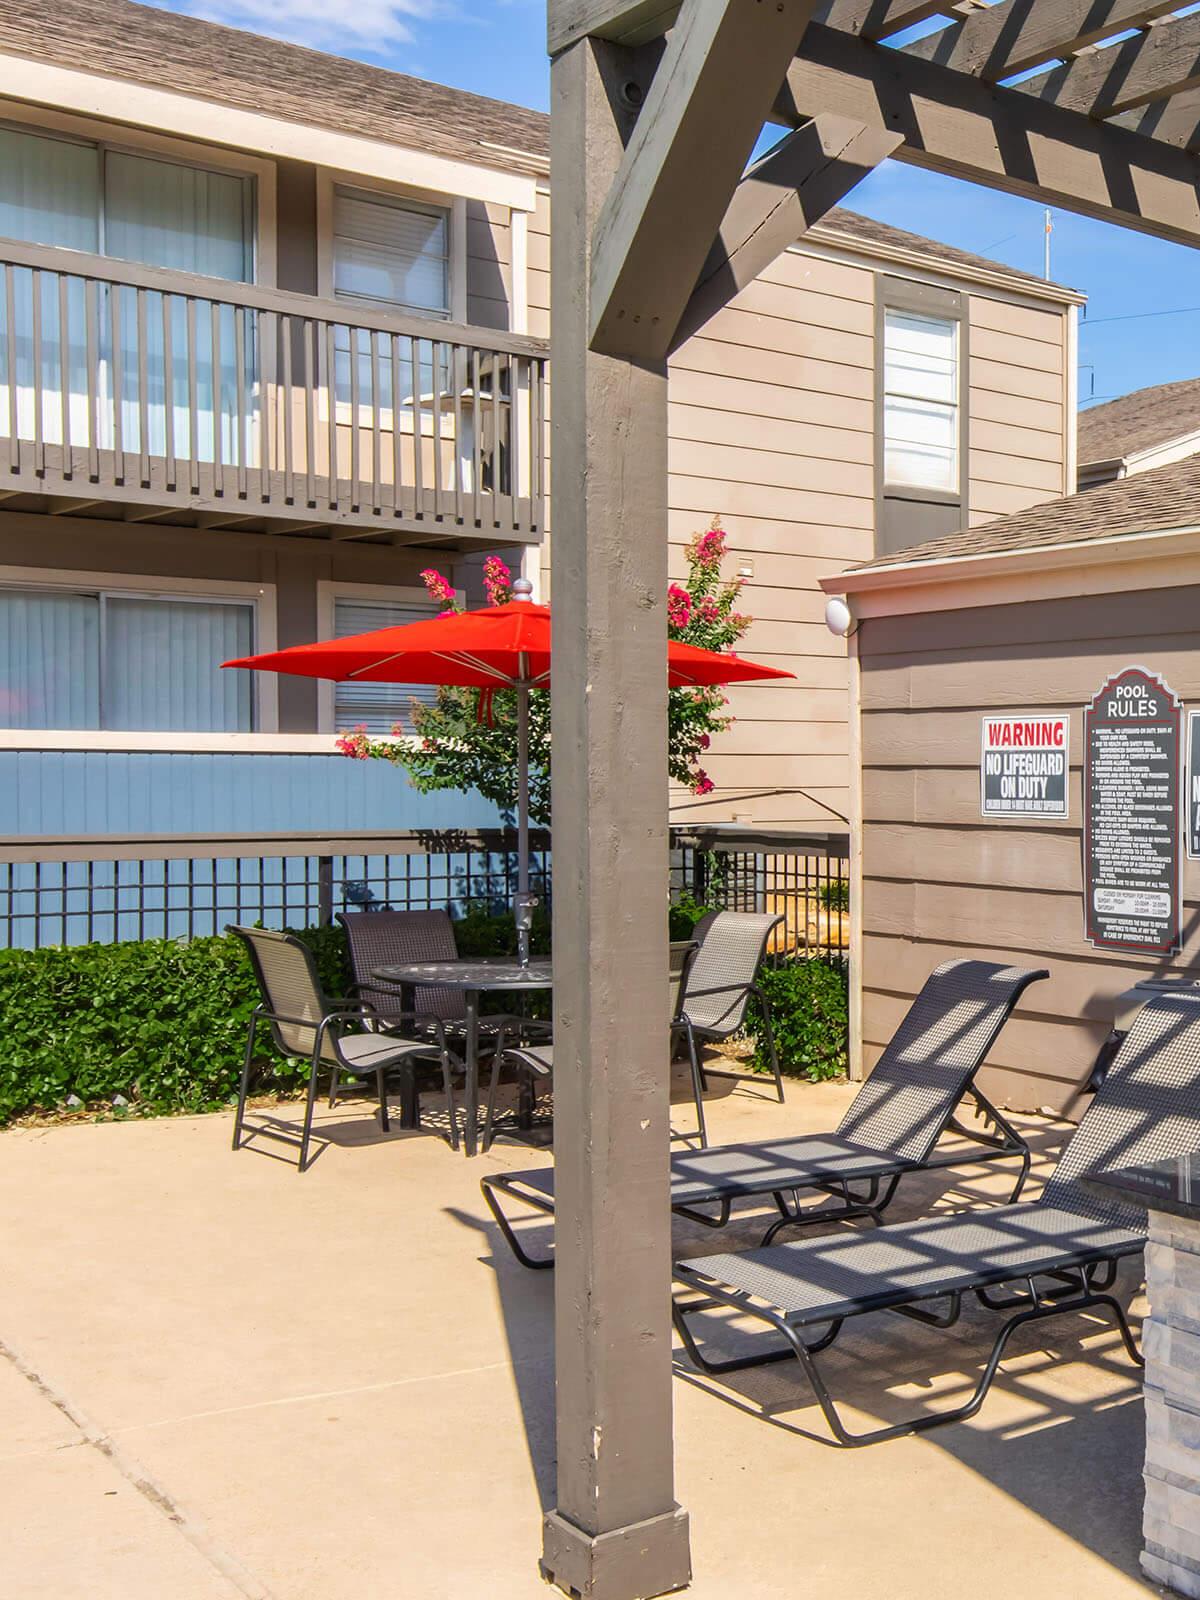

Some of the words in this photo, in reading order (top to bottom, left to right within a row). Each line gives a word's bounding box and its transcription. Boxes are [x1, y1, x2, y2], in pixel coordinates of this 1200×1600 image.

[1116, 685, 1149, 699] POOL
[1108, 700, 1158, 717] RULES
[988, 722, 1063, 746] WARNING
[986, 753, 1001, 775] NO
[1003, 753, 1063, 775] LIFEGUARD
[1001, 776, 1016, 798] ON
[1018, 776, 1048, 799] DUTY
[1193, 836, 1199, 850] IN
